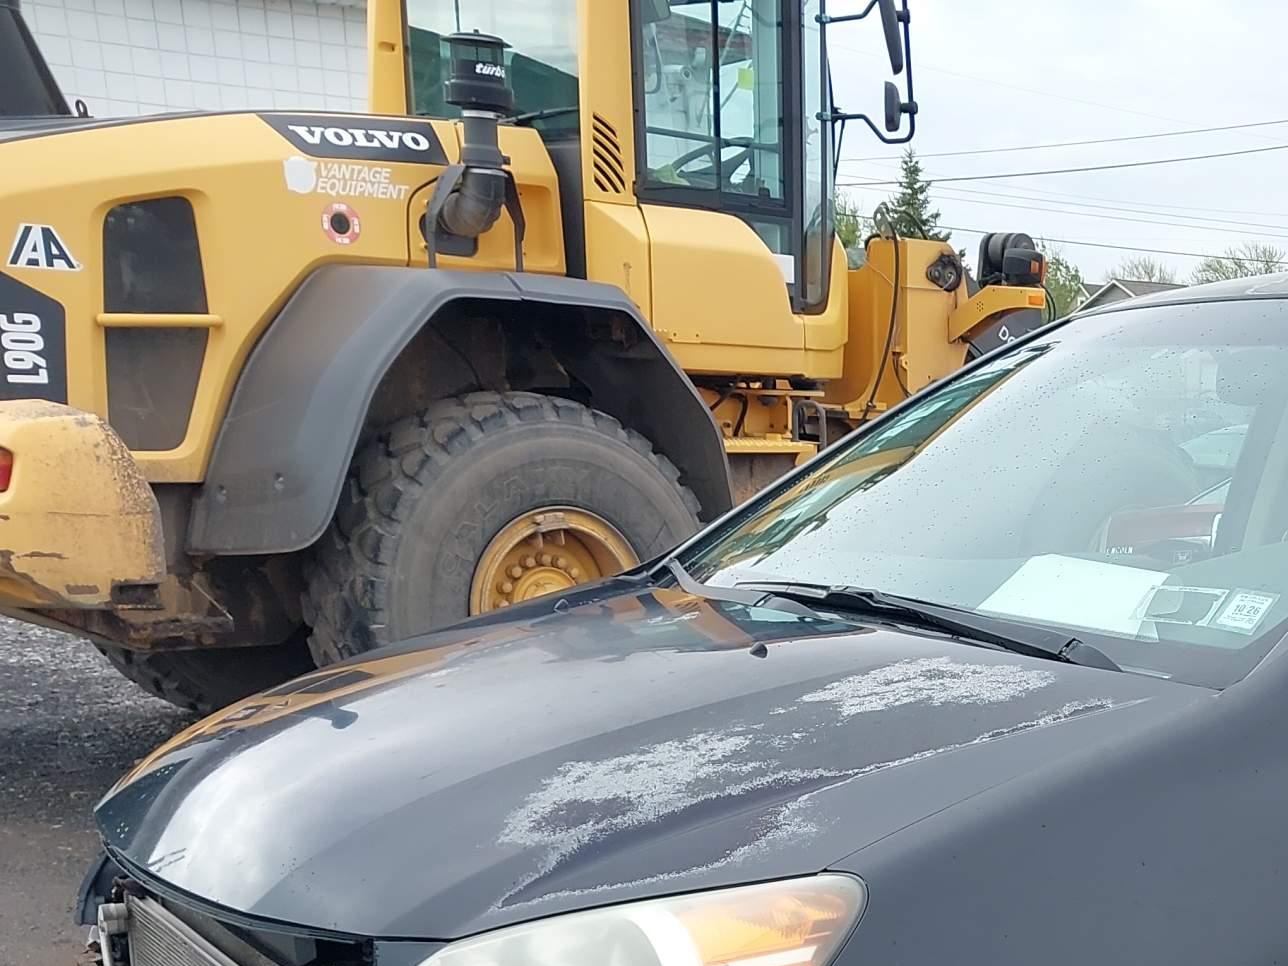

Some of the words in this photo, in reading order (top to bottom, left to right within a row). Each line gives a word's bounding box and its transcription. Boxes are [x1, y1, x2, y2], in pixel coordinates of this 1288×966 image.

[288, 125, 430, 151] VOLVO
[319, 161, 392, 184] VANTAGE
[317, 179, 410, 200] EQUIPMENT
[0, 312, 49, 384] L90G
